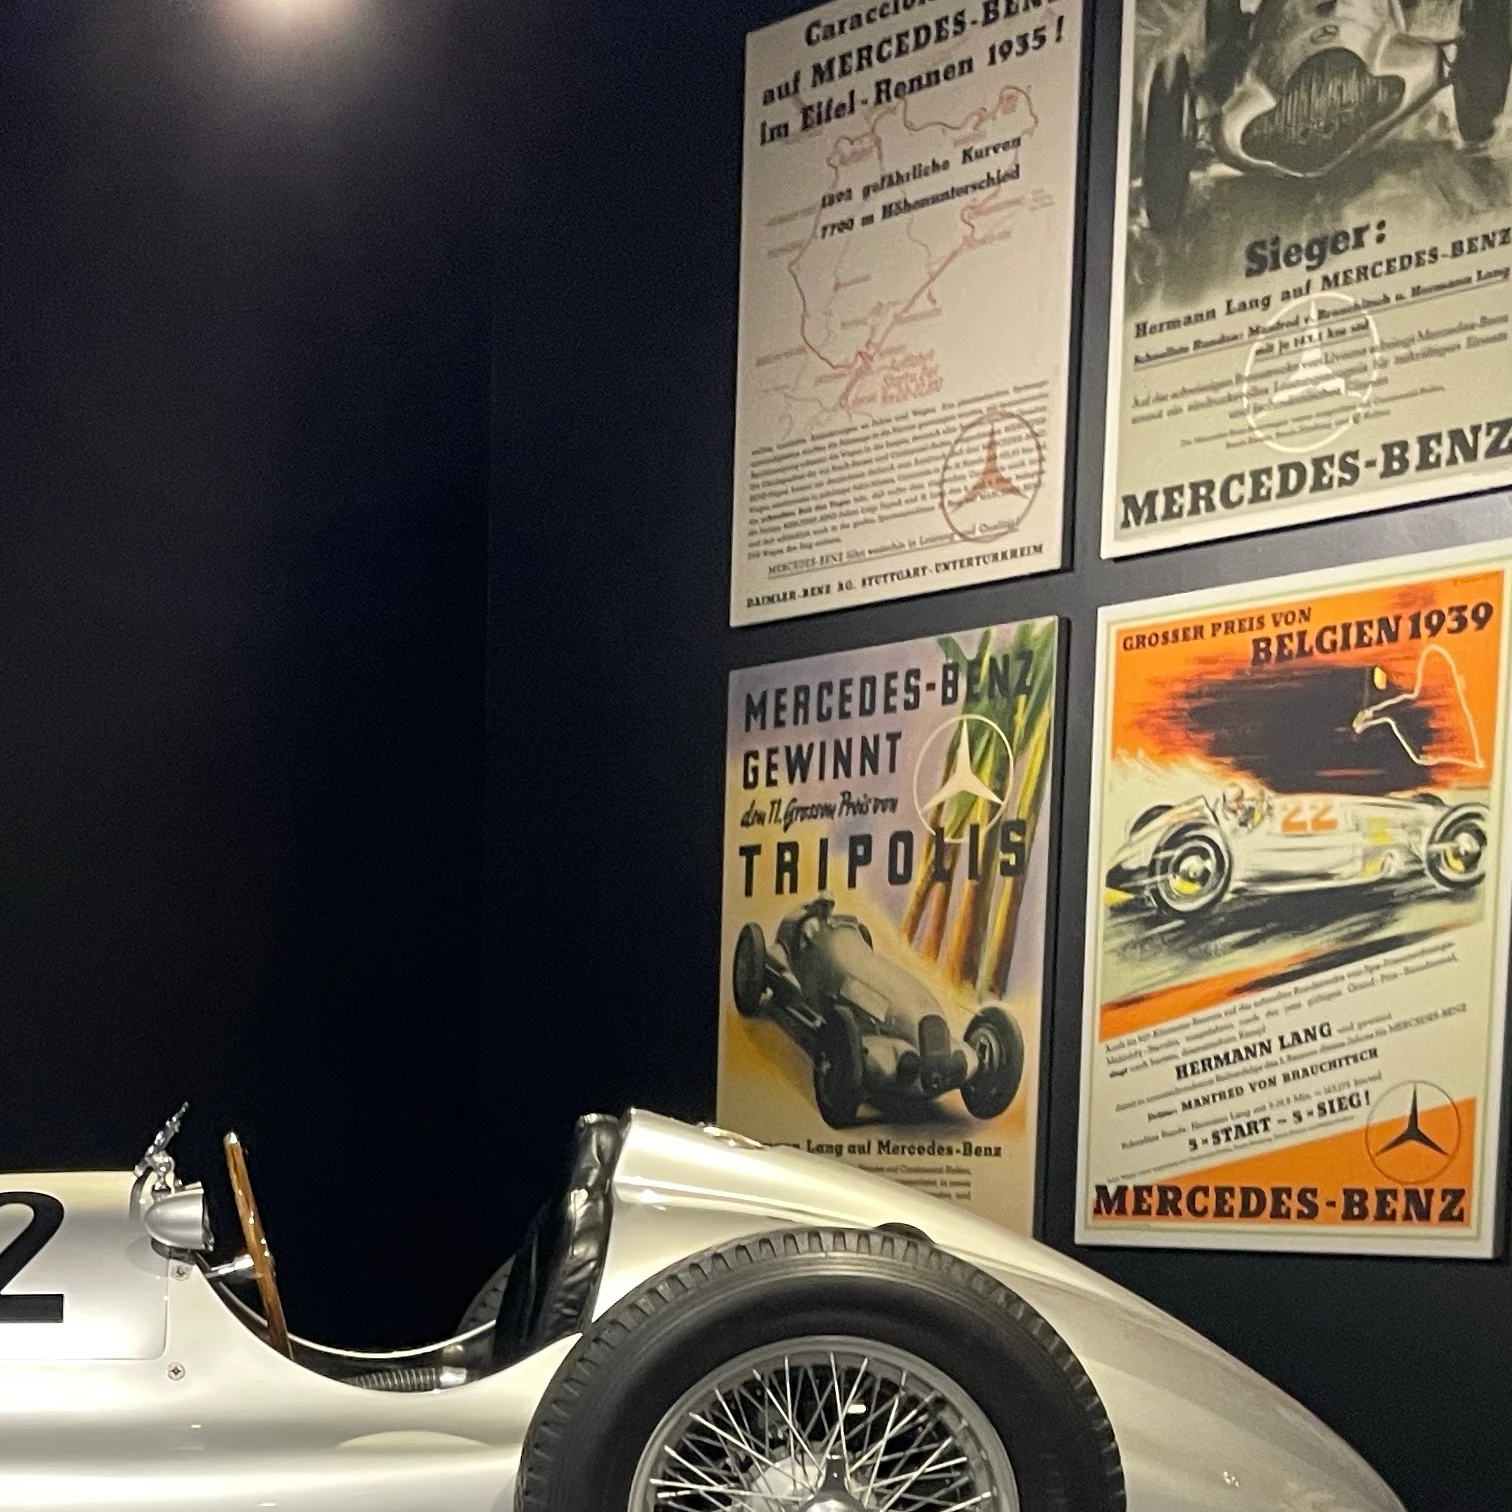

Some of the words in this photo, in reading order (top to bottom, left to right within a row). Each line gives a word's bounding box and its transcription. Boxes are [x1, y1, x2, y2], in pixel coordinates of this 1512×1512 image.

[804, 0, 936, 46] Caraccio
[762, 69, 801, 106] auf
[811, 0, 1058, 88] MERCEDES-BE
[801, 56, 974, 132] Eifel-Rennen
[1245, 220, 1386, 278] Sieger:
[1135, 308, 1216, 338] Hermann
[1225, 294, 1271, 316] Lang
[1281, 278, 1311, 301] auf
[1321, 227, 1511, 291] MERCEDES-BENZ
[1120, 419, 1512, 528] MERCEDES-BENZ
[1123, 625, 1204, 652] GROSSER
[1211, 614, 1265, 638] PREIS
[1271, 606, 1312, 628] VON
[1251, 615, 1402, 666] BELGIEN
[1409, 601, 1494, 641] 1939
[744, 650, 1036, 733] MERCEDES-BENZ
[743, 731, 902, 790] GEWINNT
[739, 819, 1026, 897] TRIPOLIS
[1176, 1039, 1272, 1080] HERMANN
[1278, 1021, 1332, 1050] LANG
[1182, 1085, 1244, 1111] MANFRED
[1249, 1076, 1277, 1093] VON
[807, 1139, 843, 1157] Lang
[848, 1139, 872, 1155] auf
[877, 1141, 1002, 1158] Mercedes-Benz
[1094, 1184, 1466, 1224] MERCEDES-BENZ
